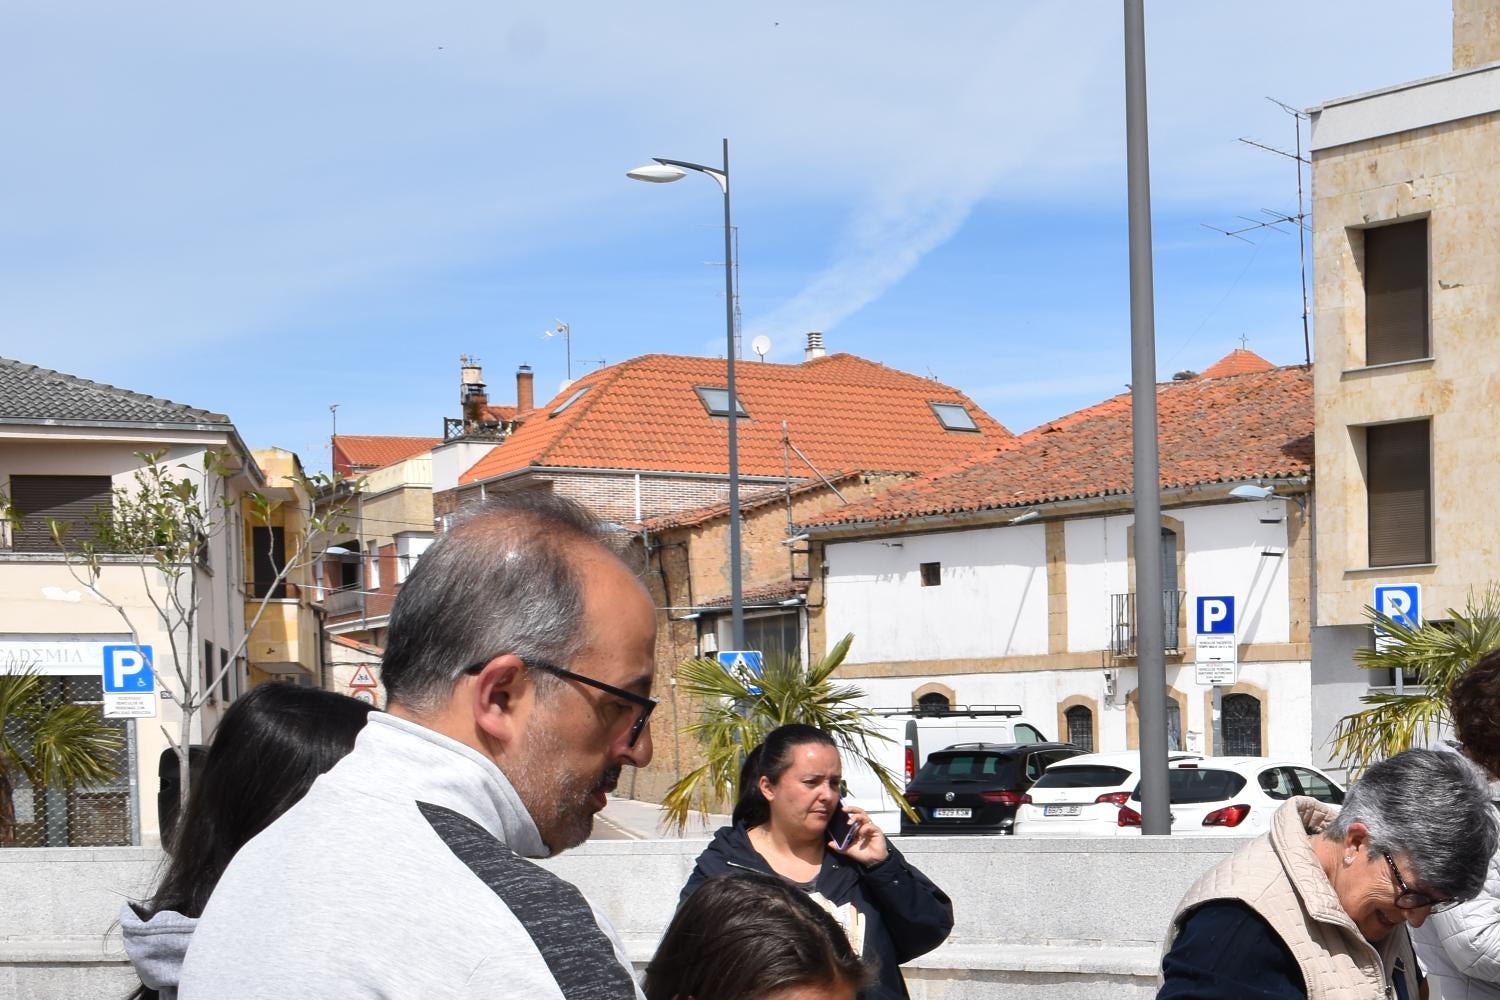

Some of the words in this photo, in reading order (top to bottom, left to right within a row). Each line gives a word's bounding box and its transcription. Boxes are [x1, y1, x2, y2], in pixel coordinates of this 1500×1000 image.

[1203, 599, 1227, 632] P
[1383, 590, 1411, 621] P
[113, 650, 145, 688] P
